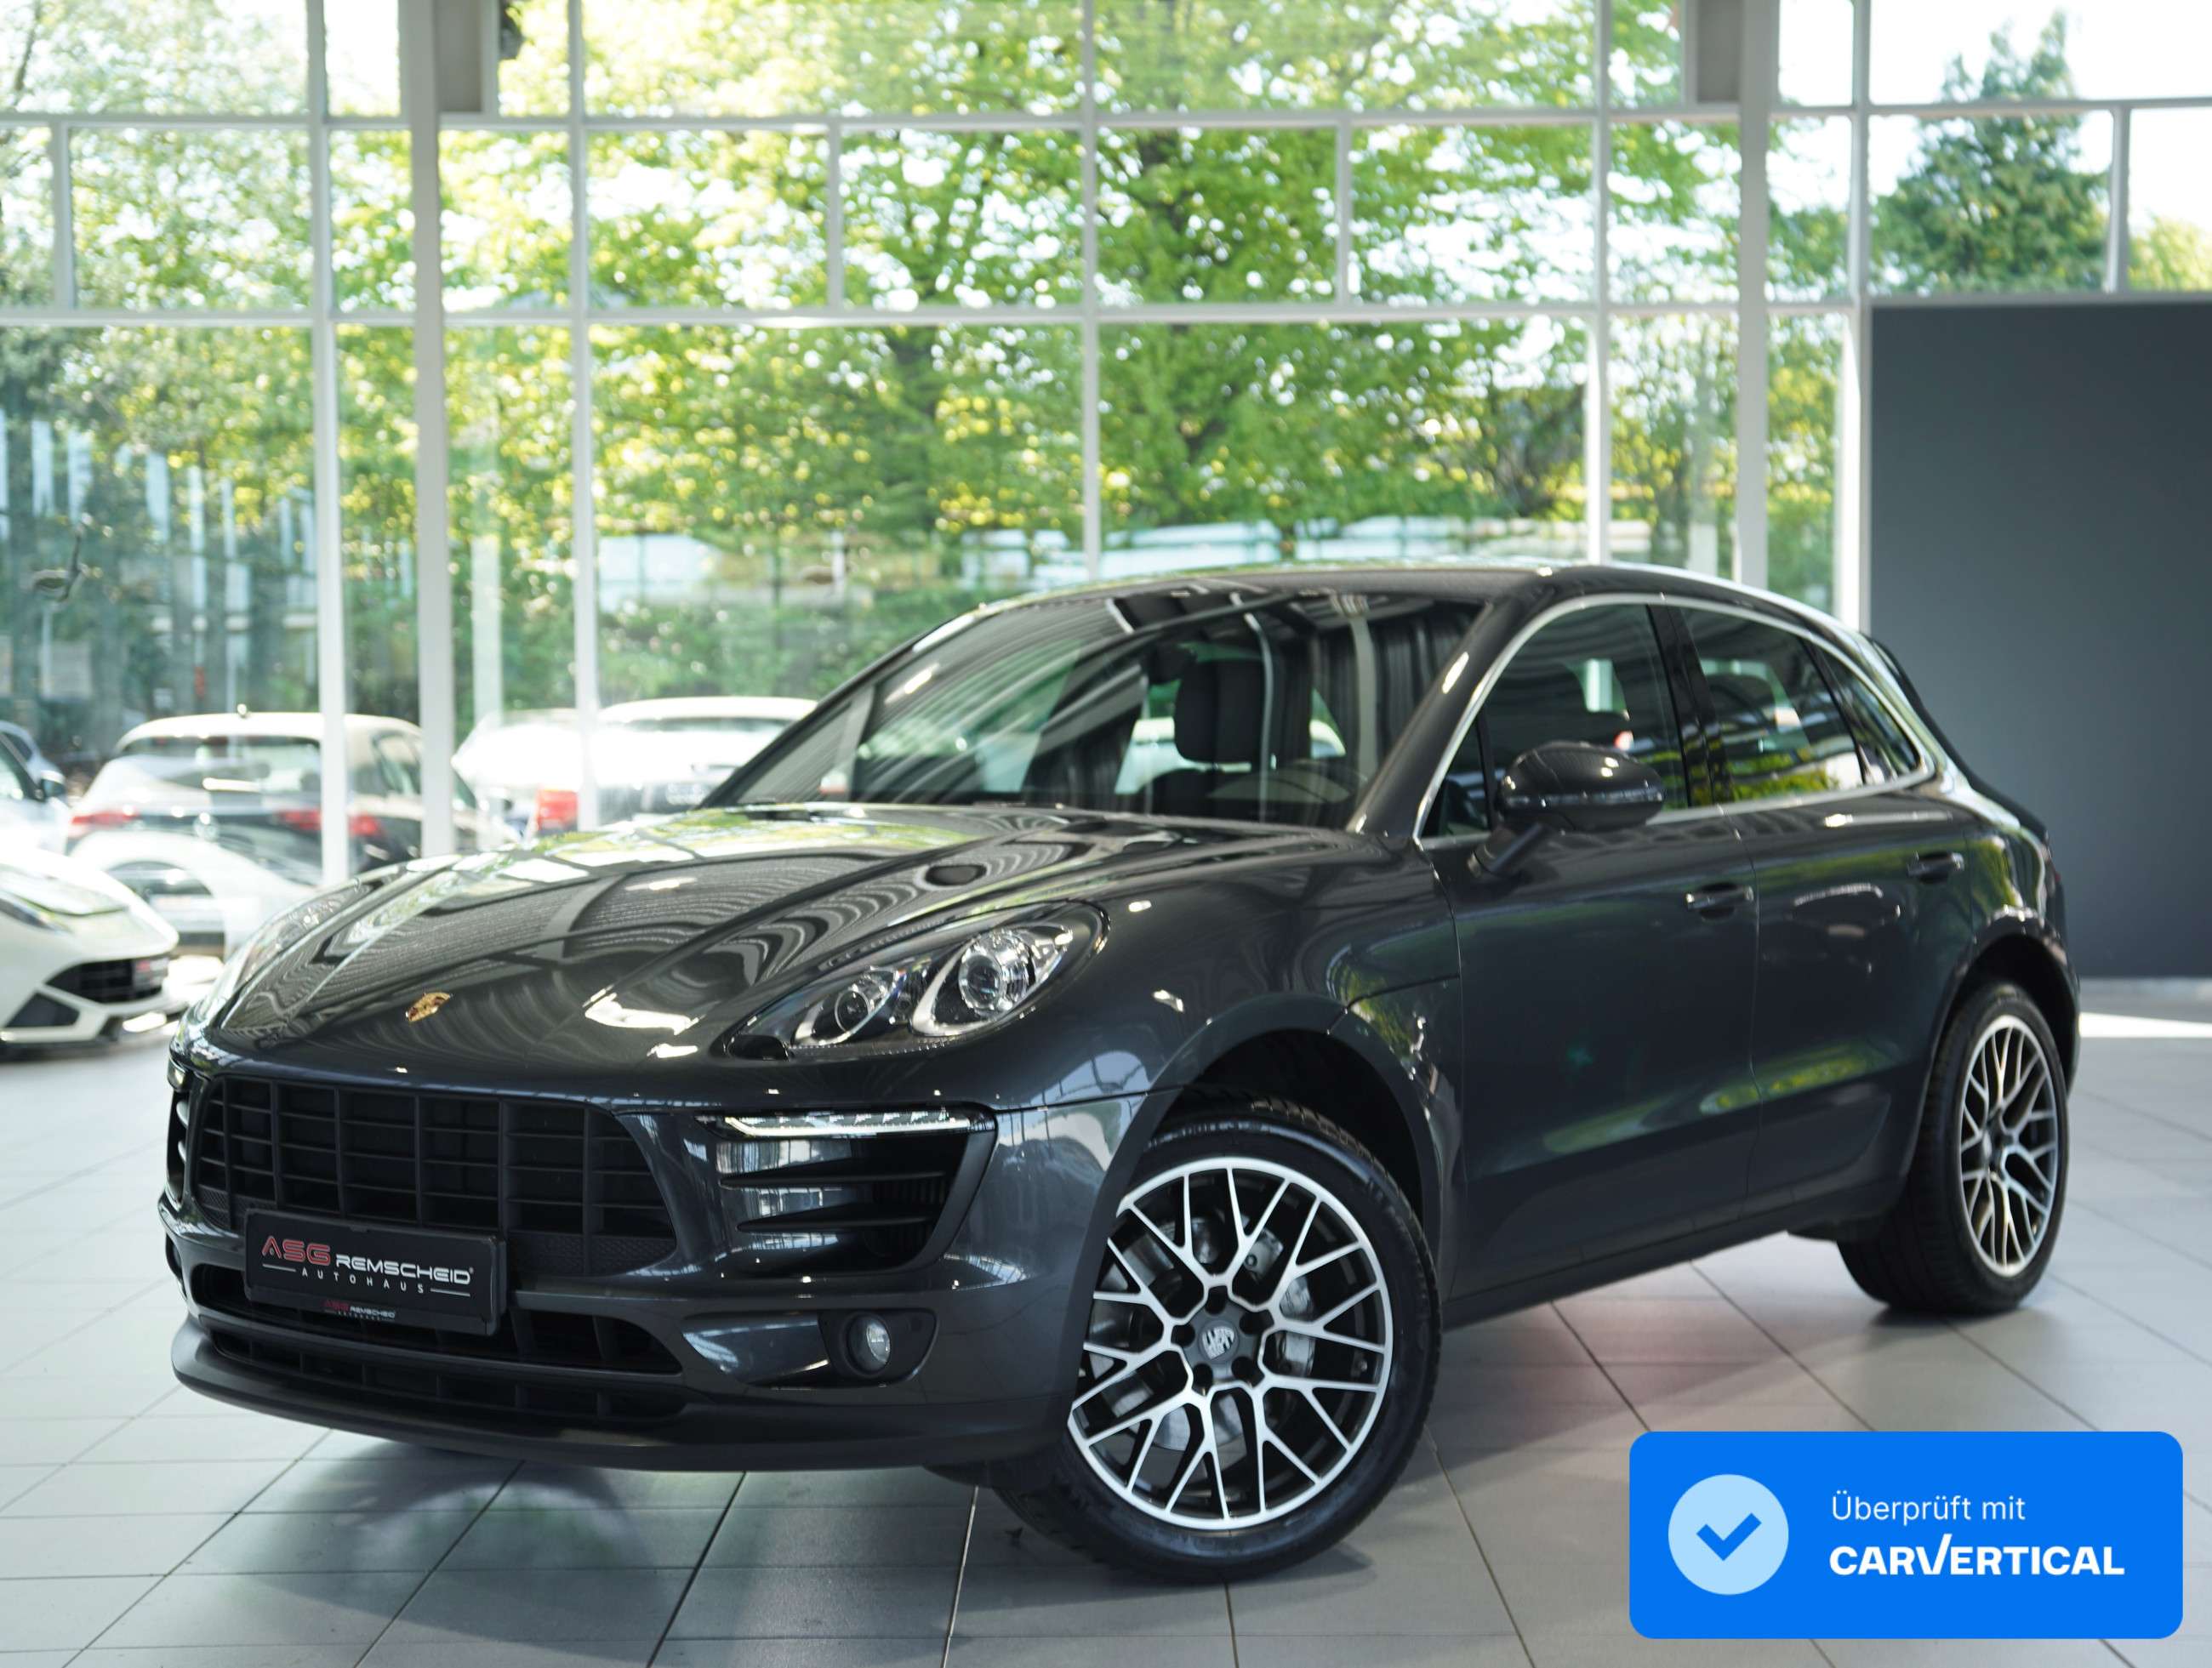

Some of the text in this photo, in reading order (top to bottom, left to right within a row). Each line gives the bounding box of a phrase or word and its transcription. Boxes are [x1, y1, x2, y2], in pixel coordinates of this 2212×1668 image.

[261, 1235, 471, 1285] ASG REMSCHEID
[301, 1267, 425, 1294] AUTOHAUS
